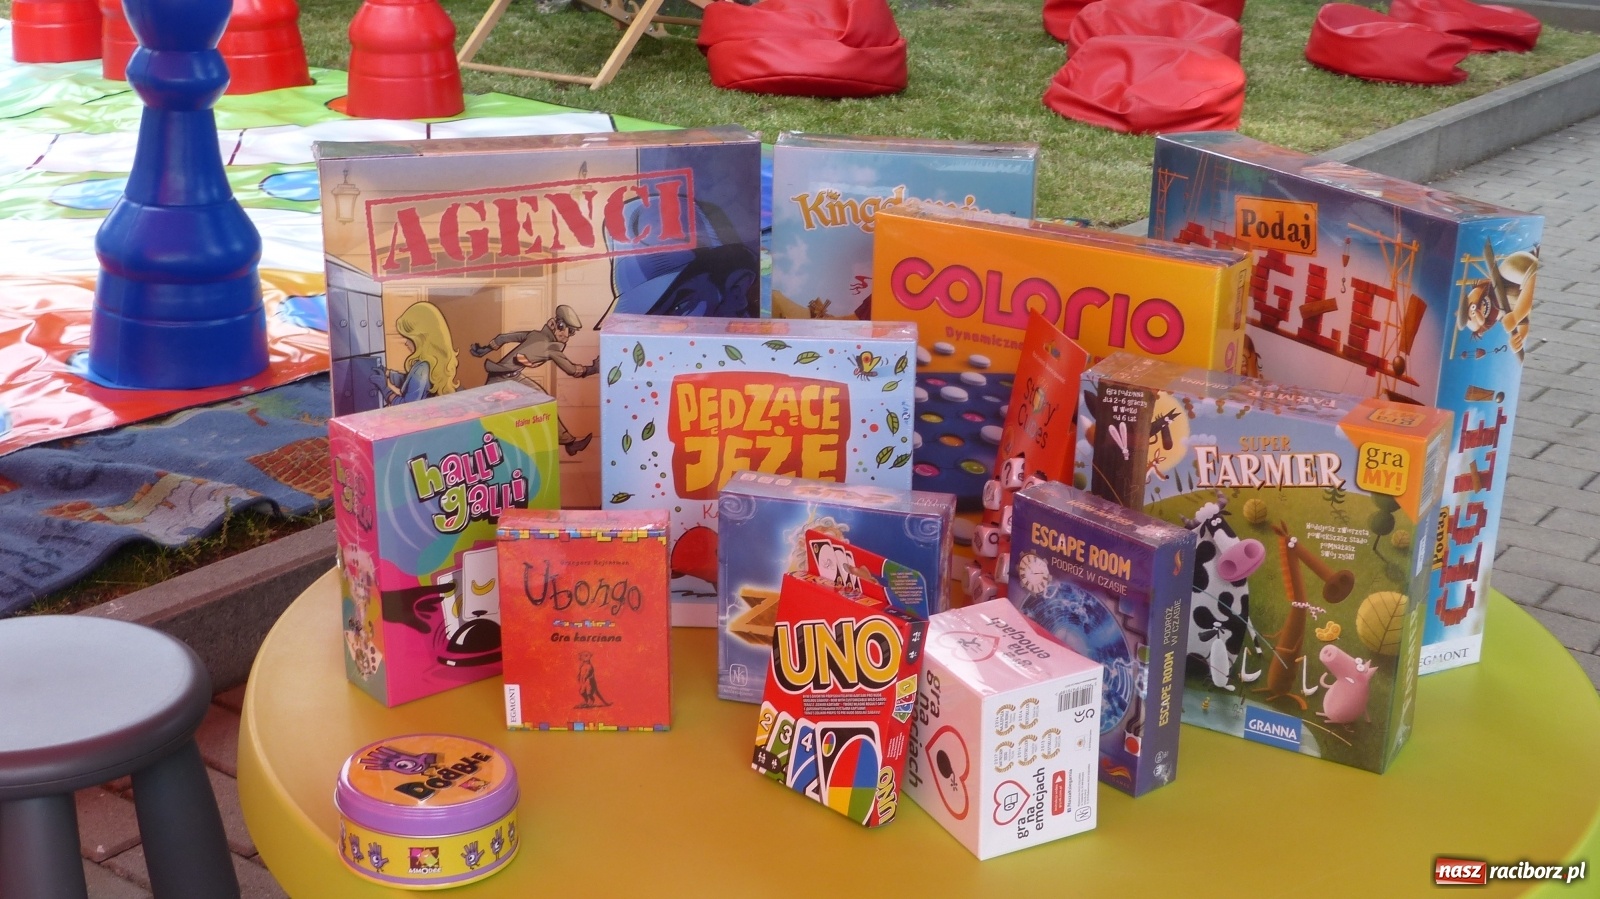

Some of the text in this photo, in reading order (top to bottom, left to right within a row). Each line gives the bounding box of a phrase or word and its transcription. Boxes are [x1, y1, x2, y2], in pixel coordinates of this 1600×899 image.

[380, 180, 686, 271] AGENCI
[1239, 207, 1312, 251] Podaj
[675, 382, 841, 435] PĘDZĄCE
[1113, 397, 1126, 405] 2-6
[683, 423, 840, 492] JEŻE
[1239, 435, 1291, 453] SUPER
[1364, 445, 1405, 470] gra
[408, 431, 505, 502] halli
[1194, 445, 1346, 491] FARMER
[1363, 469, 1404, 492] MY!
[431, 469, 530, 534] galli
[1031, 521, 1132, 581] ESCAPE ROOM
[522, 559, 643, 616] Ubongo
[1051, 556, 1129, 597] PODRÓŻ W CZASIE
[550, 632, 622, 642] Gra karciana
[984, 616, 1051, 660] emocjach
[1162, 605, 1174, 645] PODRÓŻ
[1169, 598, 1182, 646] W CZASIE
[774, 616, 904, 693] UNO
[1007, 642, 1030, 657] na
[508, 686, 517, 724] EGMONT
[919, 692, 930, 727] na
[926, 669, 942, 719] gra
[1158, 650, 1175, 727] ESCAPE ROOM
[759, 712, 774, 731] 2
[779, 724, 793, 745] 3
[800, 732, 814, 752] 4
[1248, 718, 1298, 741] GRANNA
[876, 765, 898, 825] UNO
[1025, 806, 1036, 822] na
[1032, 766, 1048, 832] emocjach
[1016, 816, 1030, 840] gra
